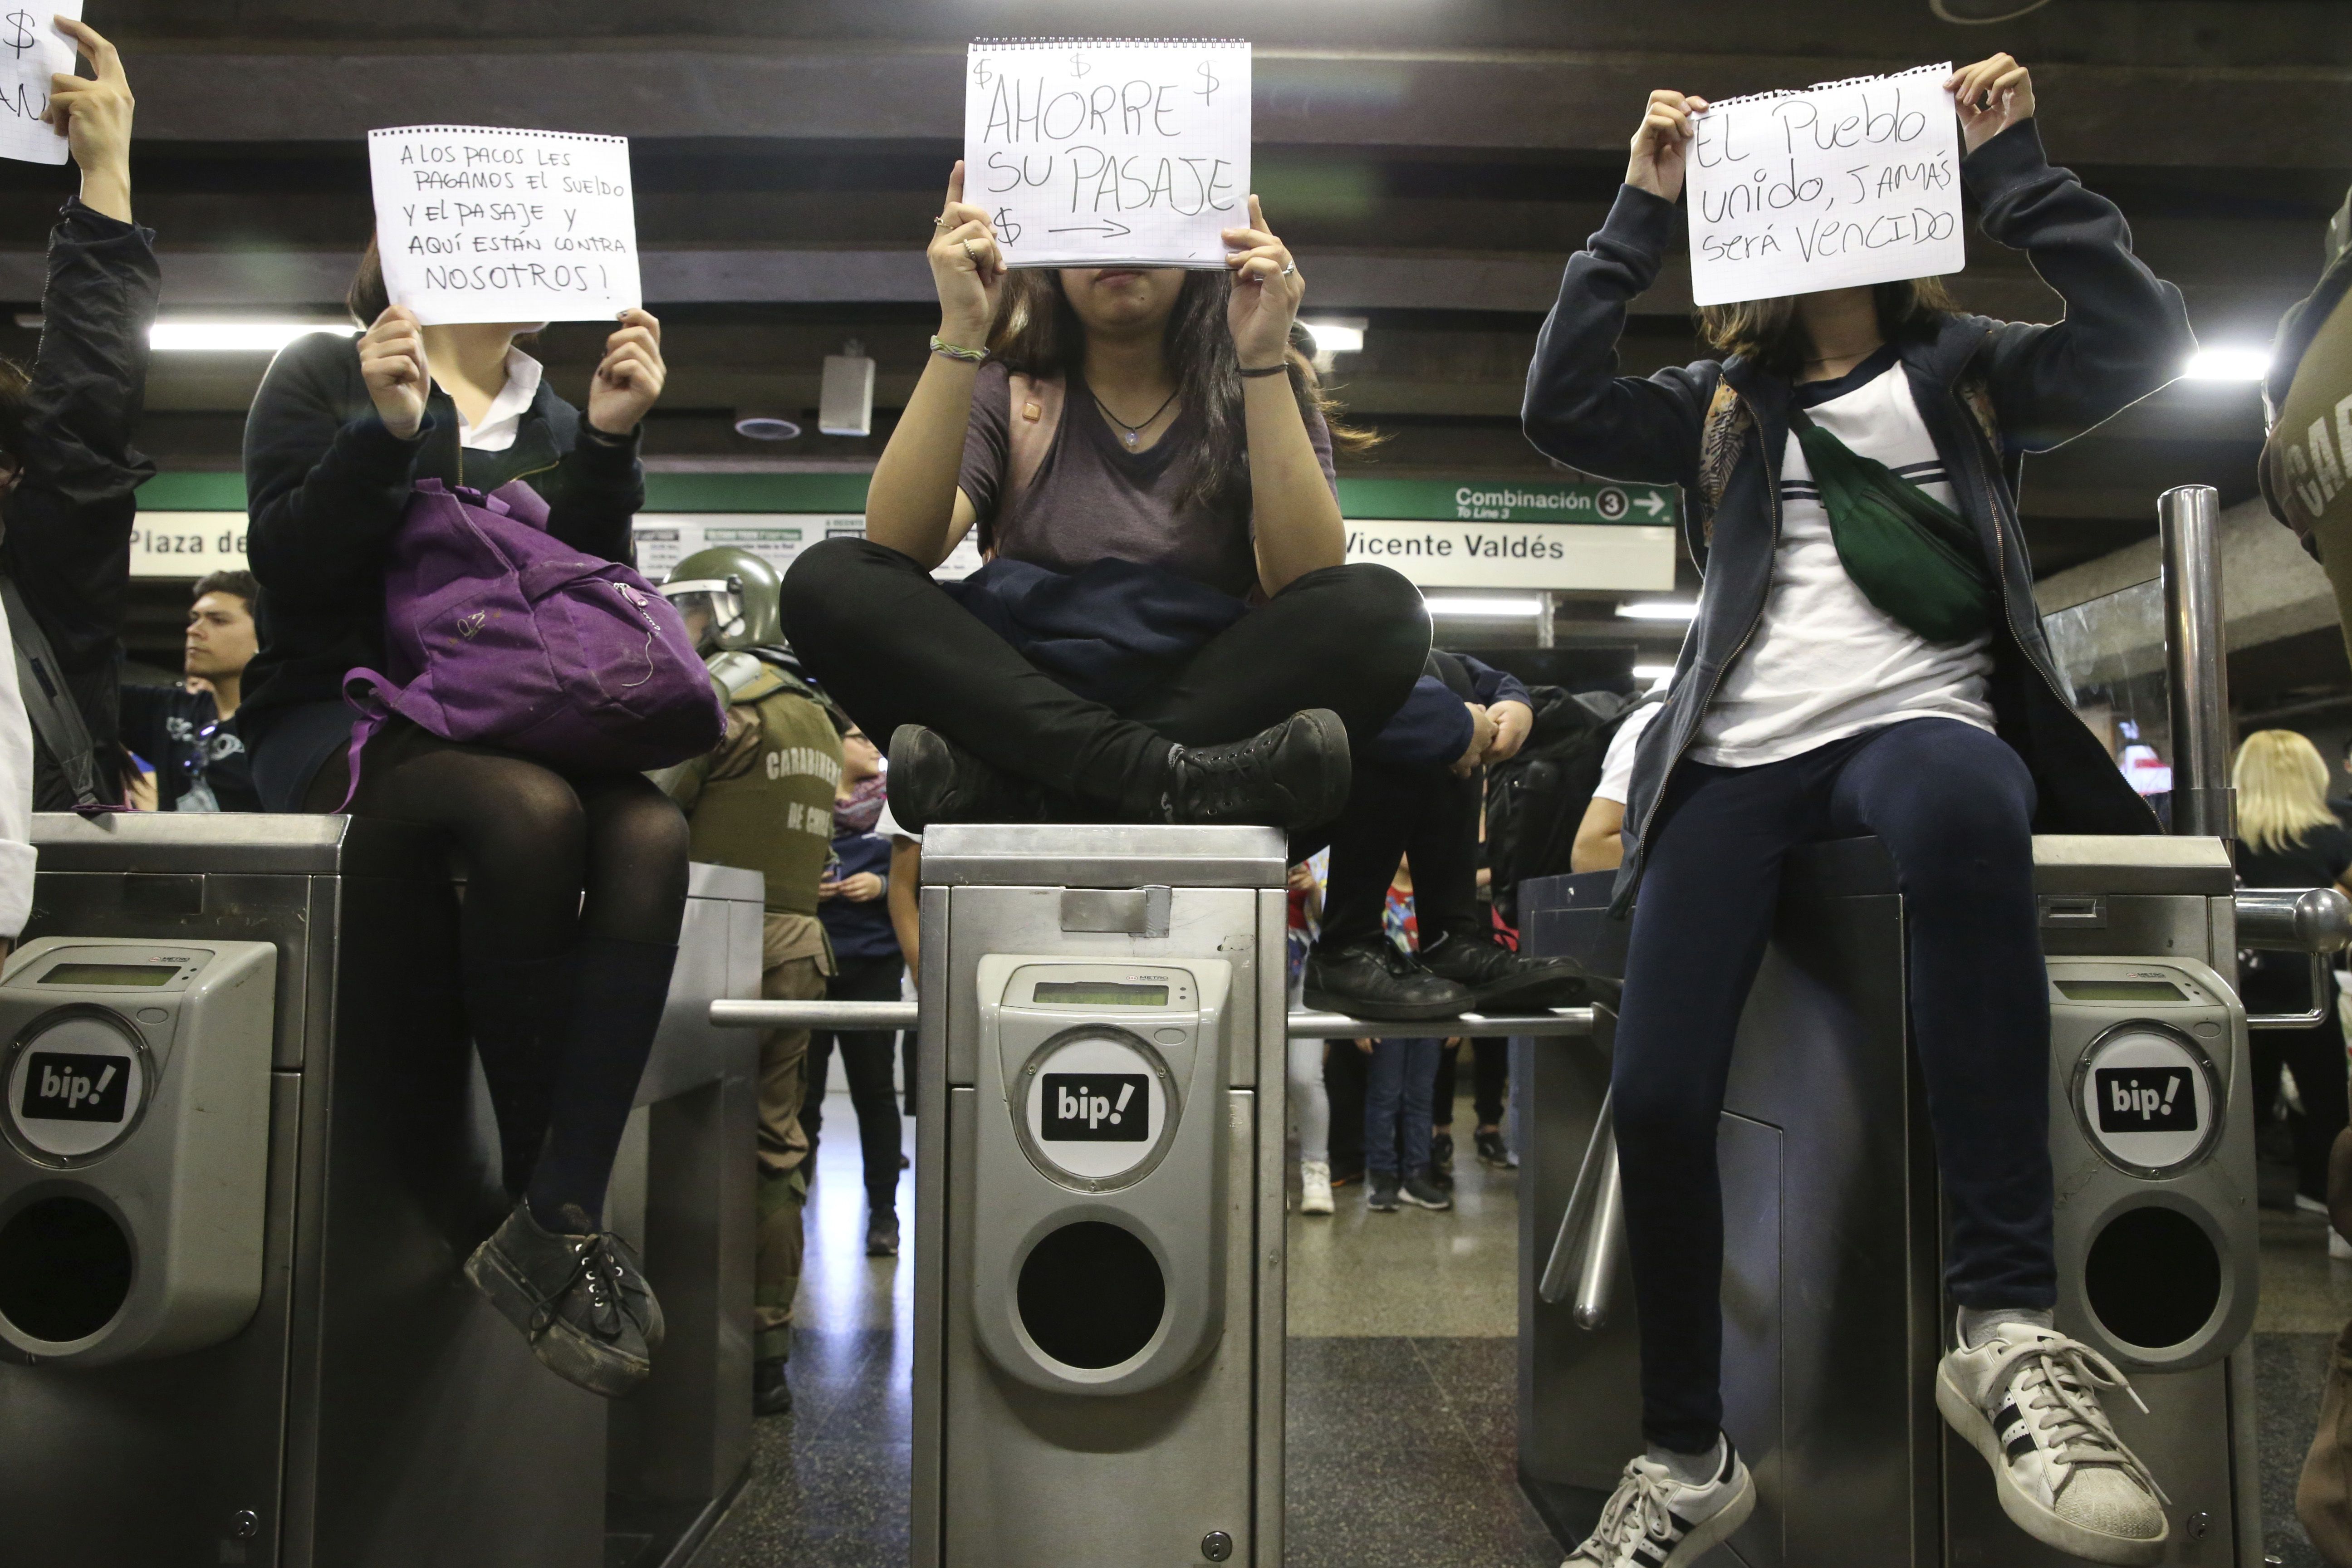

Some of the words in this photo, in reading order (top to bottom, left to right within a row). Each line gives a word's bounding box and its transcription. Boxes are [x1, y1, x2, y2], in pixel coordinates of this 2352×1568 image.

[3, 9, 35, 59] $
[973, 59, 992, 90] $
[1070, 52, 1091, 79] $
[1193, 60, 1220, 107] $
[984, 74, 1181, 144] AHORRE
[1772, 87, 1926, 154] Pueblo
[400, 145, 414, 165] A
[463, 146, 523, 167] PACOS
[538, 149, 570, 166] LES
[413, 170, 514, 191] PAGAMOS
[987, 152, 1053, 193] SU
[1064, 146, 1235, 216] PASAJE
[403, 204, 415, 226] Y
[454, 203, 544, 227] PASAJE
[993, 207, 1021, 247] $
[472, 230, 541, 253] ESTÁN
[554, 236, 626, 253] CONTRA
[1455, 487, 1591, 509] Combinación
[1604, 493, 1620, 513] 3
[218, 529, 248, 553] de
[1346, 532, 1452, 556] Vicente
[1465, 534, 1564, 559] Valdés
[40, 1064, 117, 1108] bip!
[1058, 1083, 1135, 1129] bip!
[2111, 1075, 2181, 1120] bip!
